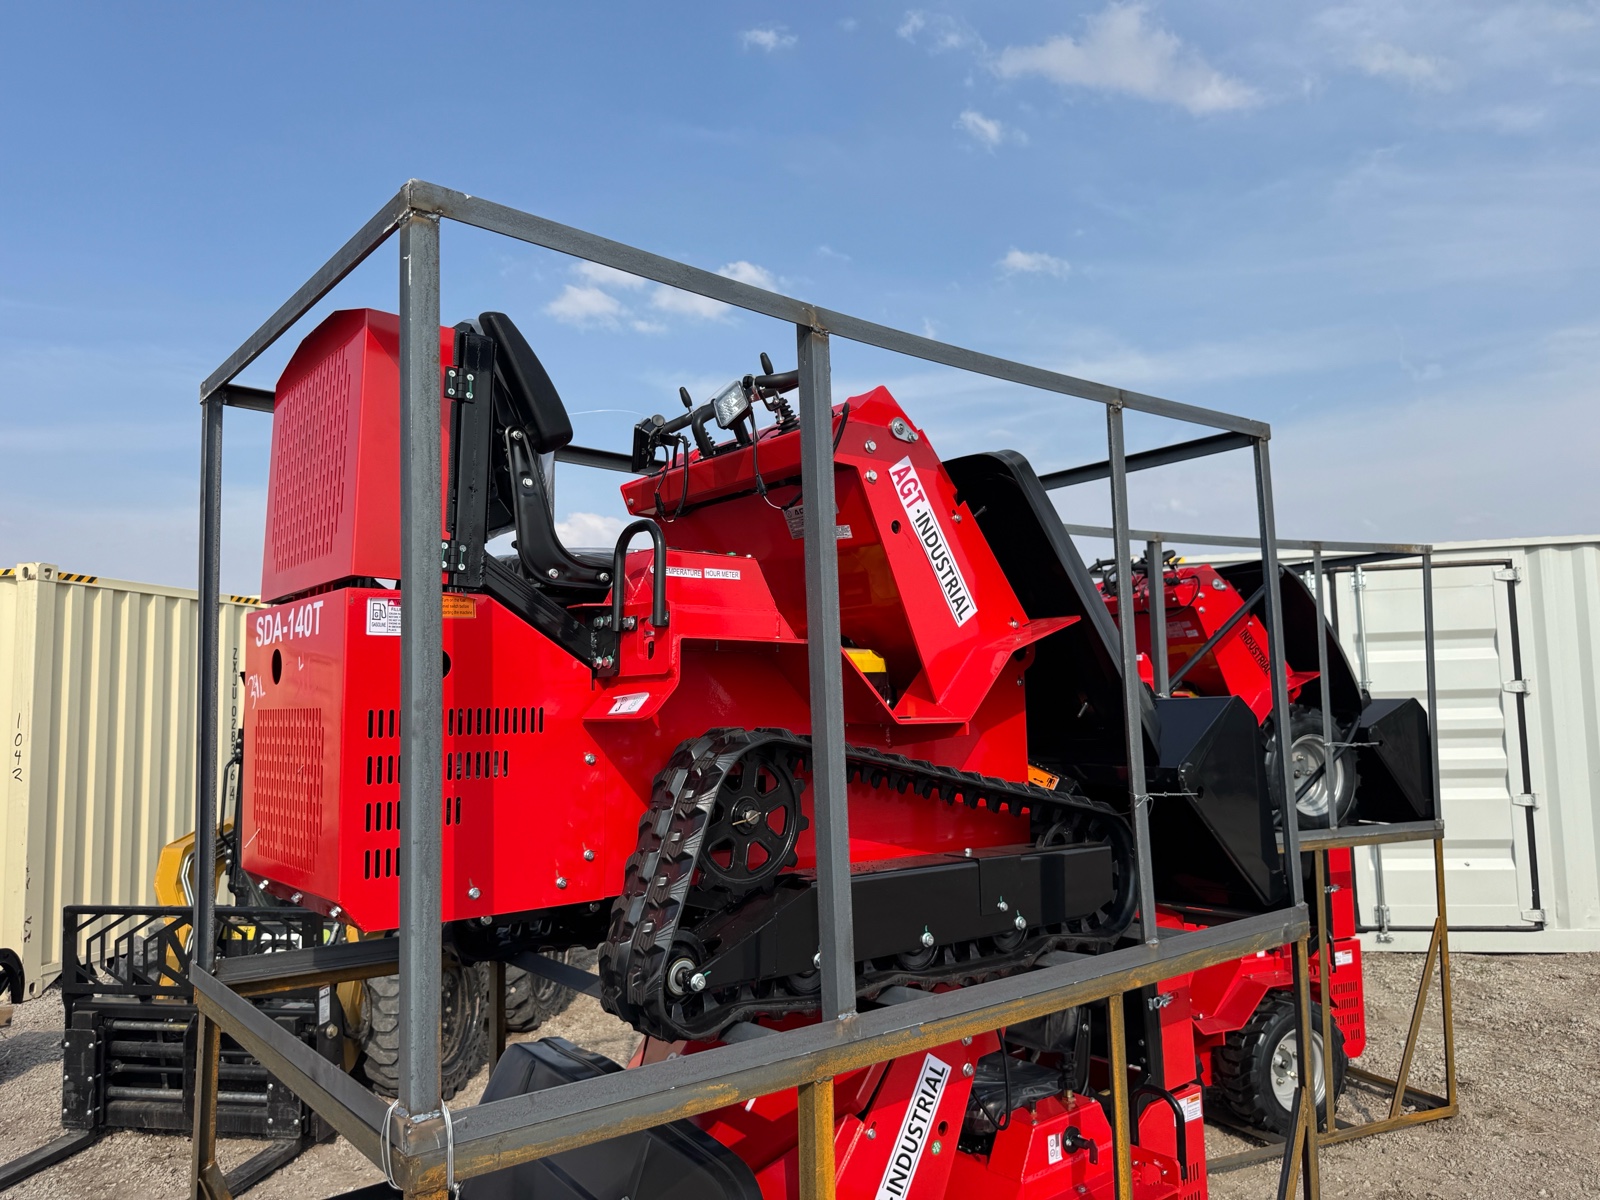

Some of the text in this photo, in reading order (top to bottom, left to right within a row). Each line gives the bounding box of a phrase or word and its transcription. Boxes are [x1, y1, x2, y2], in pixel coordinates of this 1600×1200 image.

[891, 465, 926, 509] AGT
[665, 567, 701, 577] EMPERATURE
[255, 600, 324, 647] SDA-140T
[1240, 629, 1271, 675] INDUSTRIAL
[11, 711, 23, 783] 1042
